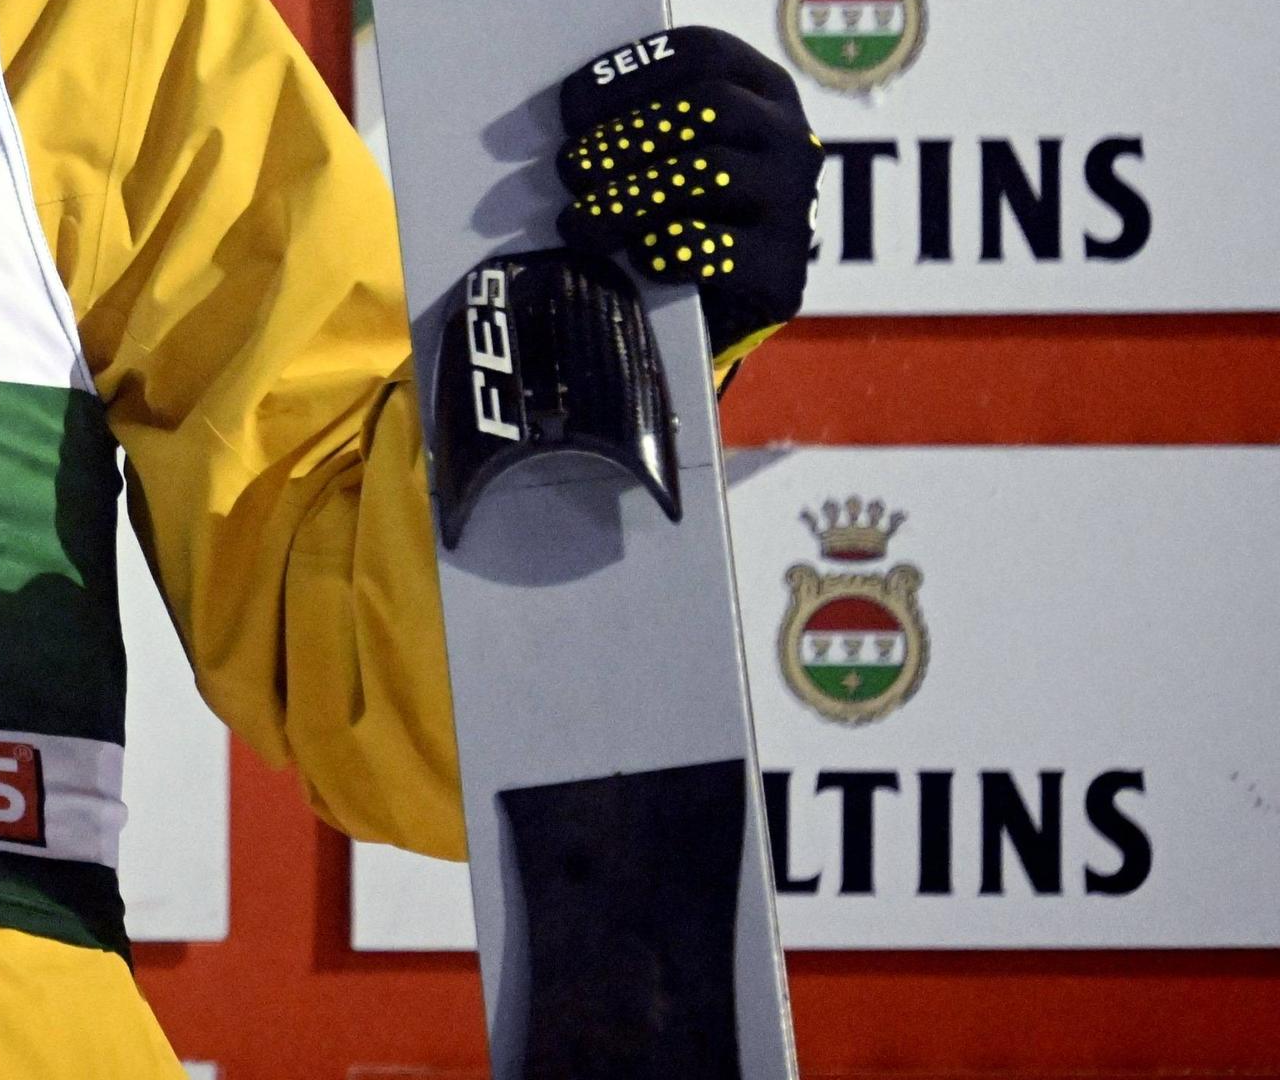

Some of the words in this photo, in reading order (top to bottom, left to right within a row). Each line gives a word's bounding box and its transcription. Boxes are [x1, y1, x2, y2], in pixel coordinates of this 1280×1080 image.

[593, 35, 675, 85] SEIZ
[810, 136, 1153, 263] TINS
[466, 270, 521, 442] FES
